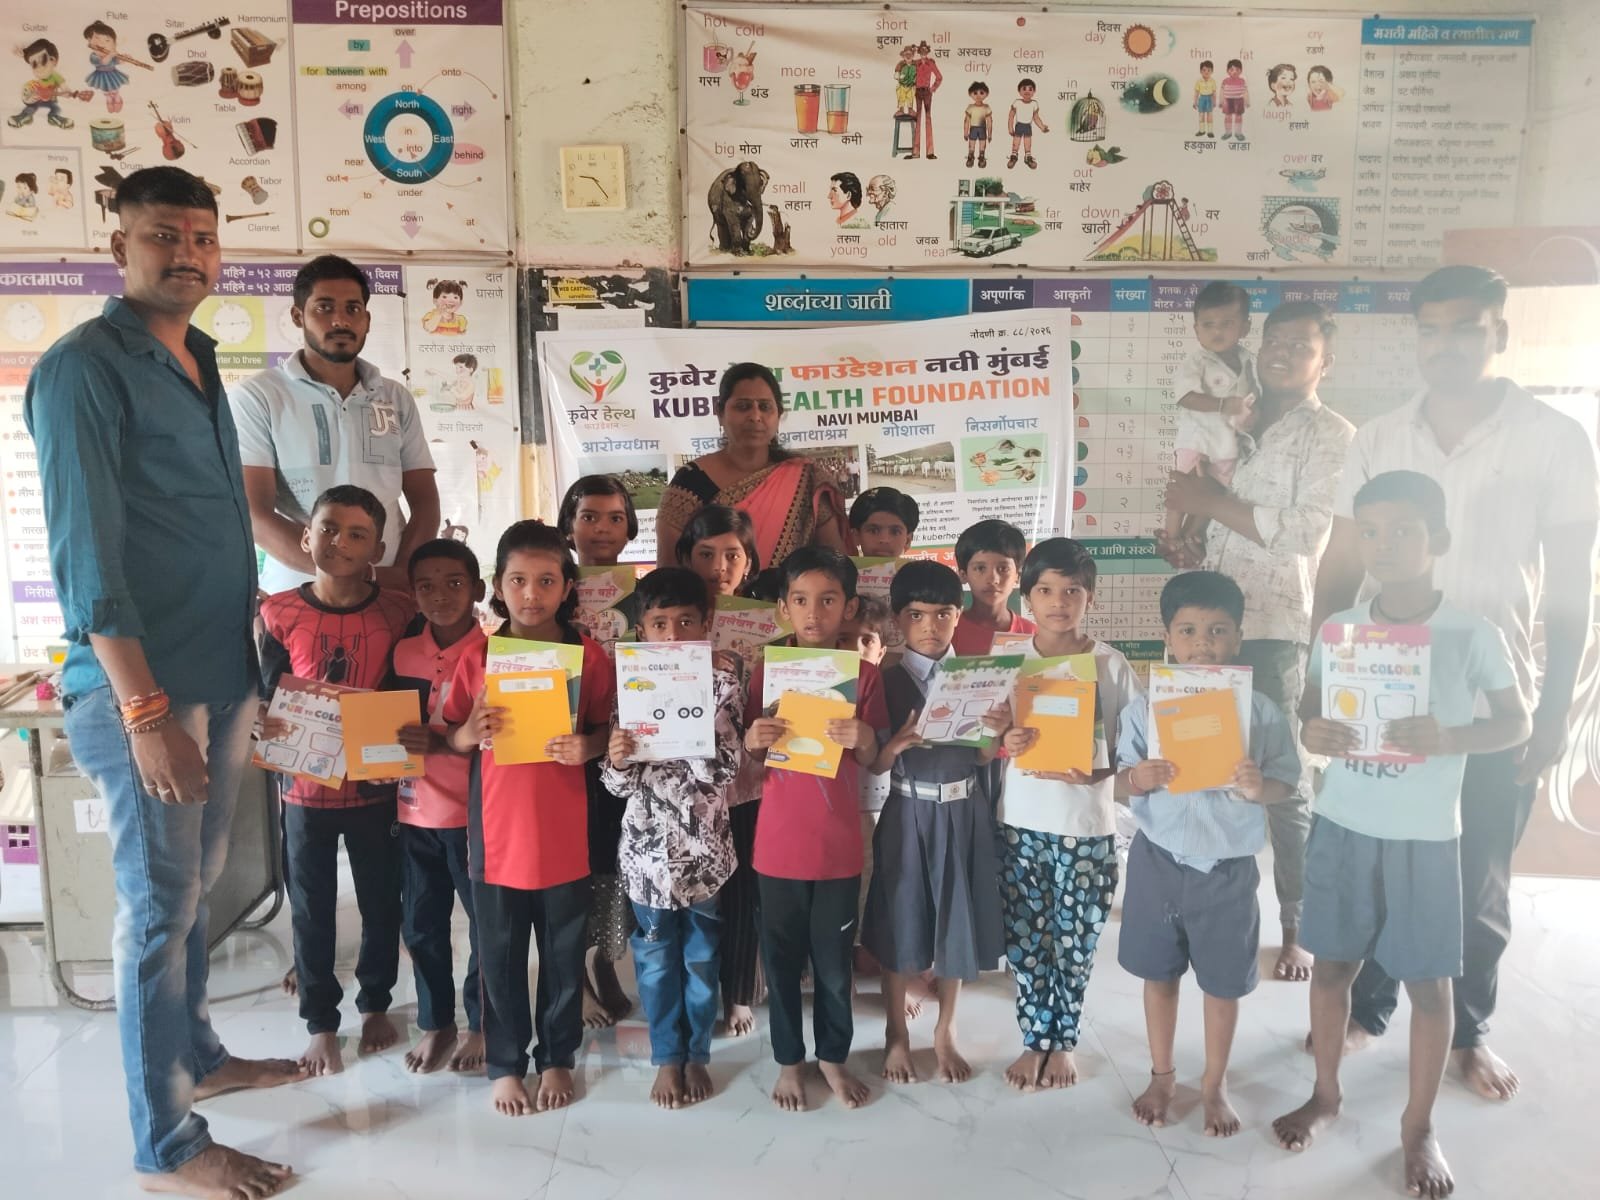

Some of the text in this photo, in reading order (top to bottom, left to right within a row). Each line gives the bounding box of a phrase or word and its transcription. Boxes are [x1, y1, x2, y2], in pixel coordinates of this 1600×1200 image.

[106, 11, 128, 20] Flute
[335, 0, 467, 21] Prepositions
[165, 19, 185, 28] Sitar
[238, 14, 287, 23] Harmonium
[704, 14, 727, 28] hot
[22, 23, 48, 32] Guitar
[875, 18, 908, 31] short
[1097, 21, 1121, 33] दिवस
[395, 28, 415, 36] over
[735, 24, 764, 37] cold
[1407, 25, 1438, 40] महिने
[932, 31, 951, 43] tall
[1085, 31, 1106, 45] day
[1307, 31, 1323, 42] cry
[353, 40, 364, 49] by
[877, 36, 903, 49] बुटका
[187, 50, 207, 58] Dhol
[957, 47, 992, 58] अस्वच्छ
[1013, 47, 1044, 59] clean
[1190, 48, 1212, 59] thin
[1239, 49, 1254, 60] fat
[306, 67, 387, 76] for between with
[781, 67, 816, 77] more
[837, 66, 862, 79] less
[964, 61, 992, 75] dirty
[1017, 64, 1043, 74] स्वच्छ
[1108, 64, 1138, 78] night
[699, 76, 721, 87] गरम
[1067, 78, 1077, 88] in
[336, 84, 367, 92] among
[751, 86, 769, 98] थंड
[214, 103, 236, 112] Tabla
[345, 106, 359, 114] left
[395, 100, 420, 109] North
[452, 106, 472, 116] right
[1263, 110, 1292, 123] laugh
[168, 115, 191, 124] Violin
[404, 127, 412, 135] in
[364, 135, 385, 143] West
[433, 135, 454, 143] East
[790, 138, 819, 149] जास्त
[841, 133, 863, 145] कमी
[715, 142, 762, 158] big मोठा
[1184, 141, 1217, 153] हडकुळा
[1228, 141, 1251, 151] जाडा
[454, 151, 484, 159] behind
[1283, 154, 1323, 163] over वर
[120, 161, 143, 170] Drum
[229, 157, 270, 166] Accordian
[344, 158, 364, 166] near
[396, 169, 422, 177] South
[1073, 168, 1093, 178] out
[259, 177, 282, 185] Tabor
[772, 182, 806, 194] small
[1069, 181, 1091, 193] बाहेर
[398, 189, 423, 197] under
[784, 200, 811, 210] लहान
[330, 208, 349, 216] from
[1046, 207, 1061, 218] far
[1081, 205, 1120, 218] down
[1206, 209, 1220, 220] वर
[401, 214, 424, 222] down
[248, 223, 280, 232] Clarinet
[1081, 220, 1111, 234] खाली
[1191, 221, 1208, 235] up
[92, 230, 112, 238] Pian
[877, 234, 897, 246] old
[831, 245, 868, 258] young
[924, 247, 950, 258] near
[1247, 250, 1270, 261] खाली
[223, 266, 270, 279] महिने ५२
[375, 268, 398, 280] दिवस
[0, 272, 84, 287] कालमापन
[222, 280, 270, 293] महिने ५२
[375, 283, 398, 294] दिवस
[476, 288, 504, 299] घासणे
[980, 286, 1146, 304] अपूर्णांक आकृती संख्या
[765, 288, 892, 313] शब्दांच्या जाती
[242, 355, 262, 364] three
[649, 363, 717, 395] कुबेर
[790, 356, 917, 381] फाउंडेशन
[924, 350, 979, 374] नवी
[987, 345, 1050, 376] मुंबई
[653, 377, 1050, 418] KUB EALTH FOUNDATION
[567, 405, 636, 425] कुबेर हेल्थ
[817, 409, 918, 427] NAVI MUMBAI
[582, 415, 1039, 453] आरोग्यधाम अनाथाश्रम गोशाला निसर्गोपचार
[1370, 663, 1421, 676] COLOUR
[314, 710, 342, 722] COLO
